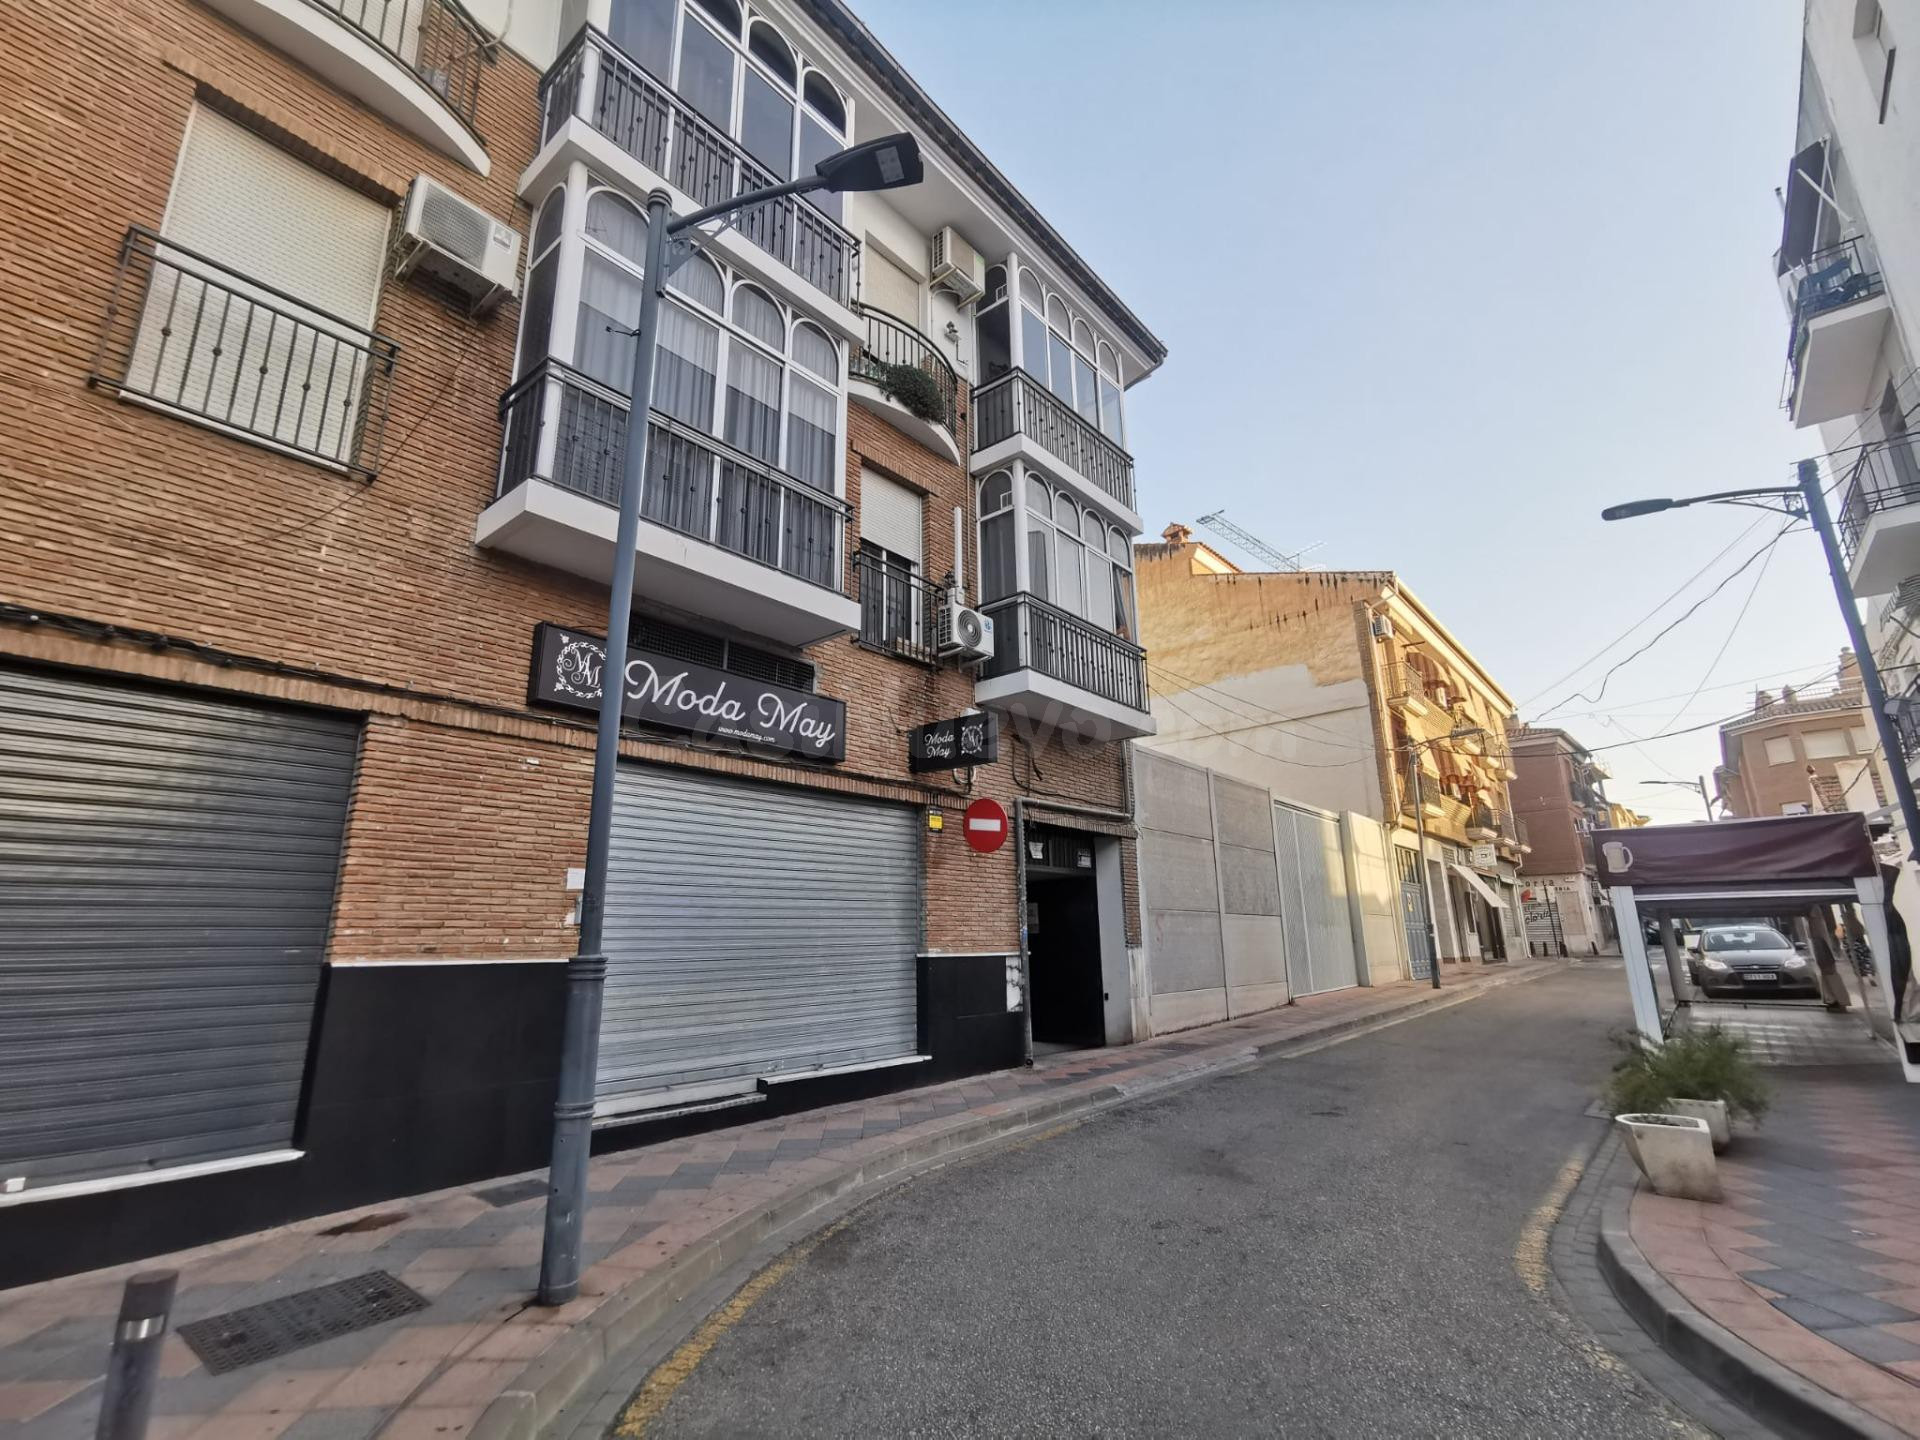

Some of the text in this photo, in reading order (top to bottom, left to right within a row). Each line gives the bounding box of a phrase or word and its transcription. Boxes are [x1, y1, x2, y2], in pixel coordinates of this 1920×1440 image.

[624, 660, 836, 748] Moda May
[924, 730, 955, 746] Moda
[926, 744, 950, 759] May
